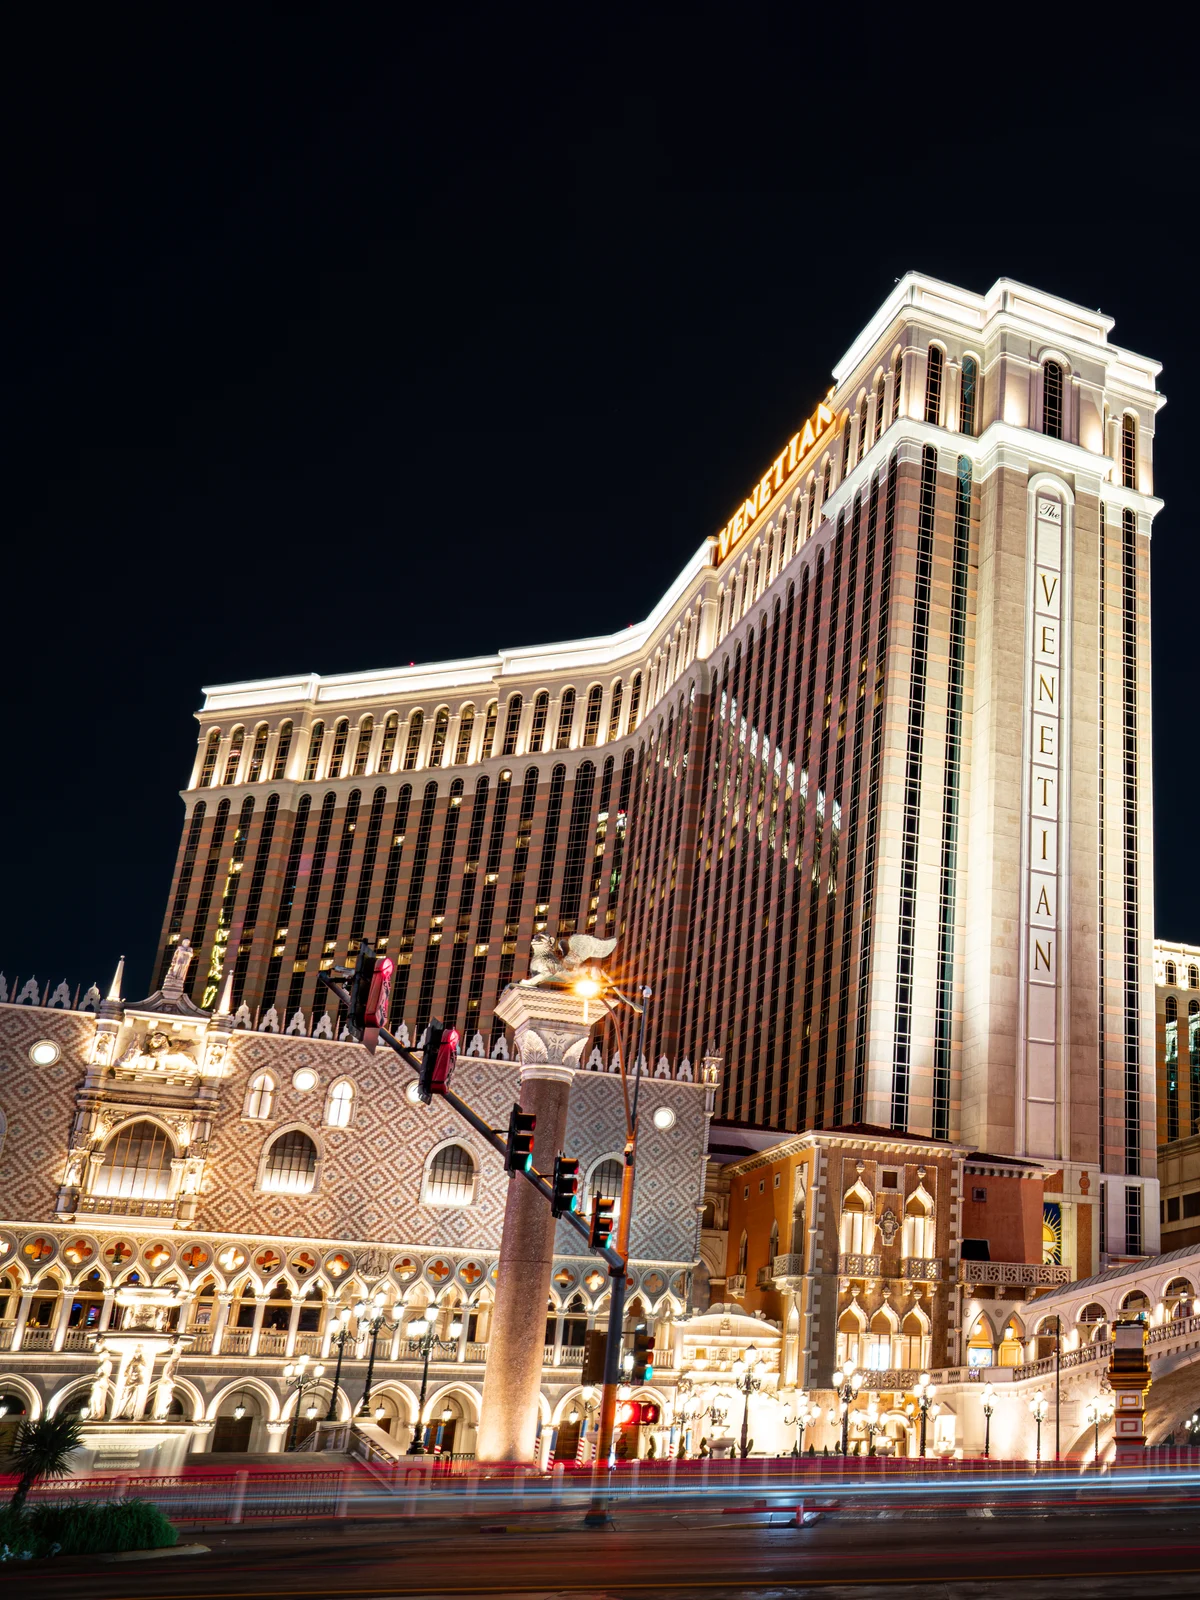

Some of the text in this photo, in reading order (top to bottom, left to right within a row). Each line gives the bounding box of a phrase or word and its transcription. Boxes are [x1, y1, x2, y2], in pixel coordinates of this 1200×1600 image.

[719, 386, 835, 559] VENETIAN
[1039, 502, 1060, 519] The
[1034, 573, 1058, 973] VENETIAN
